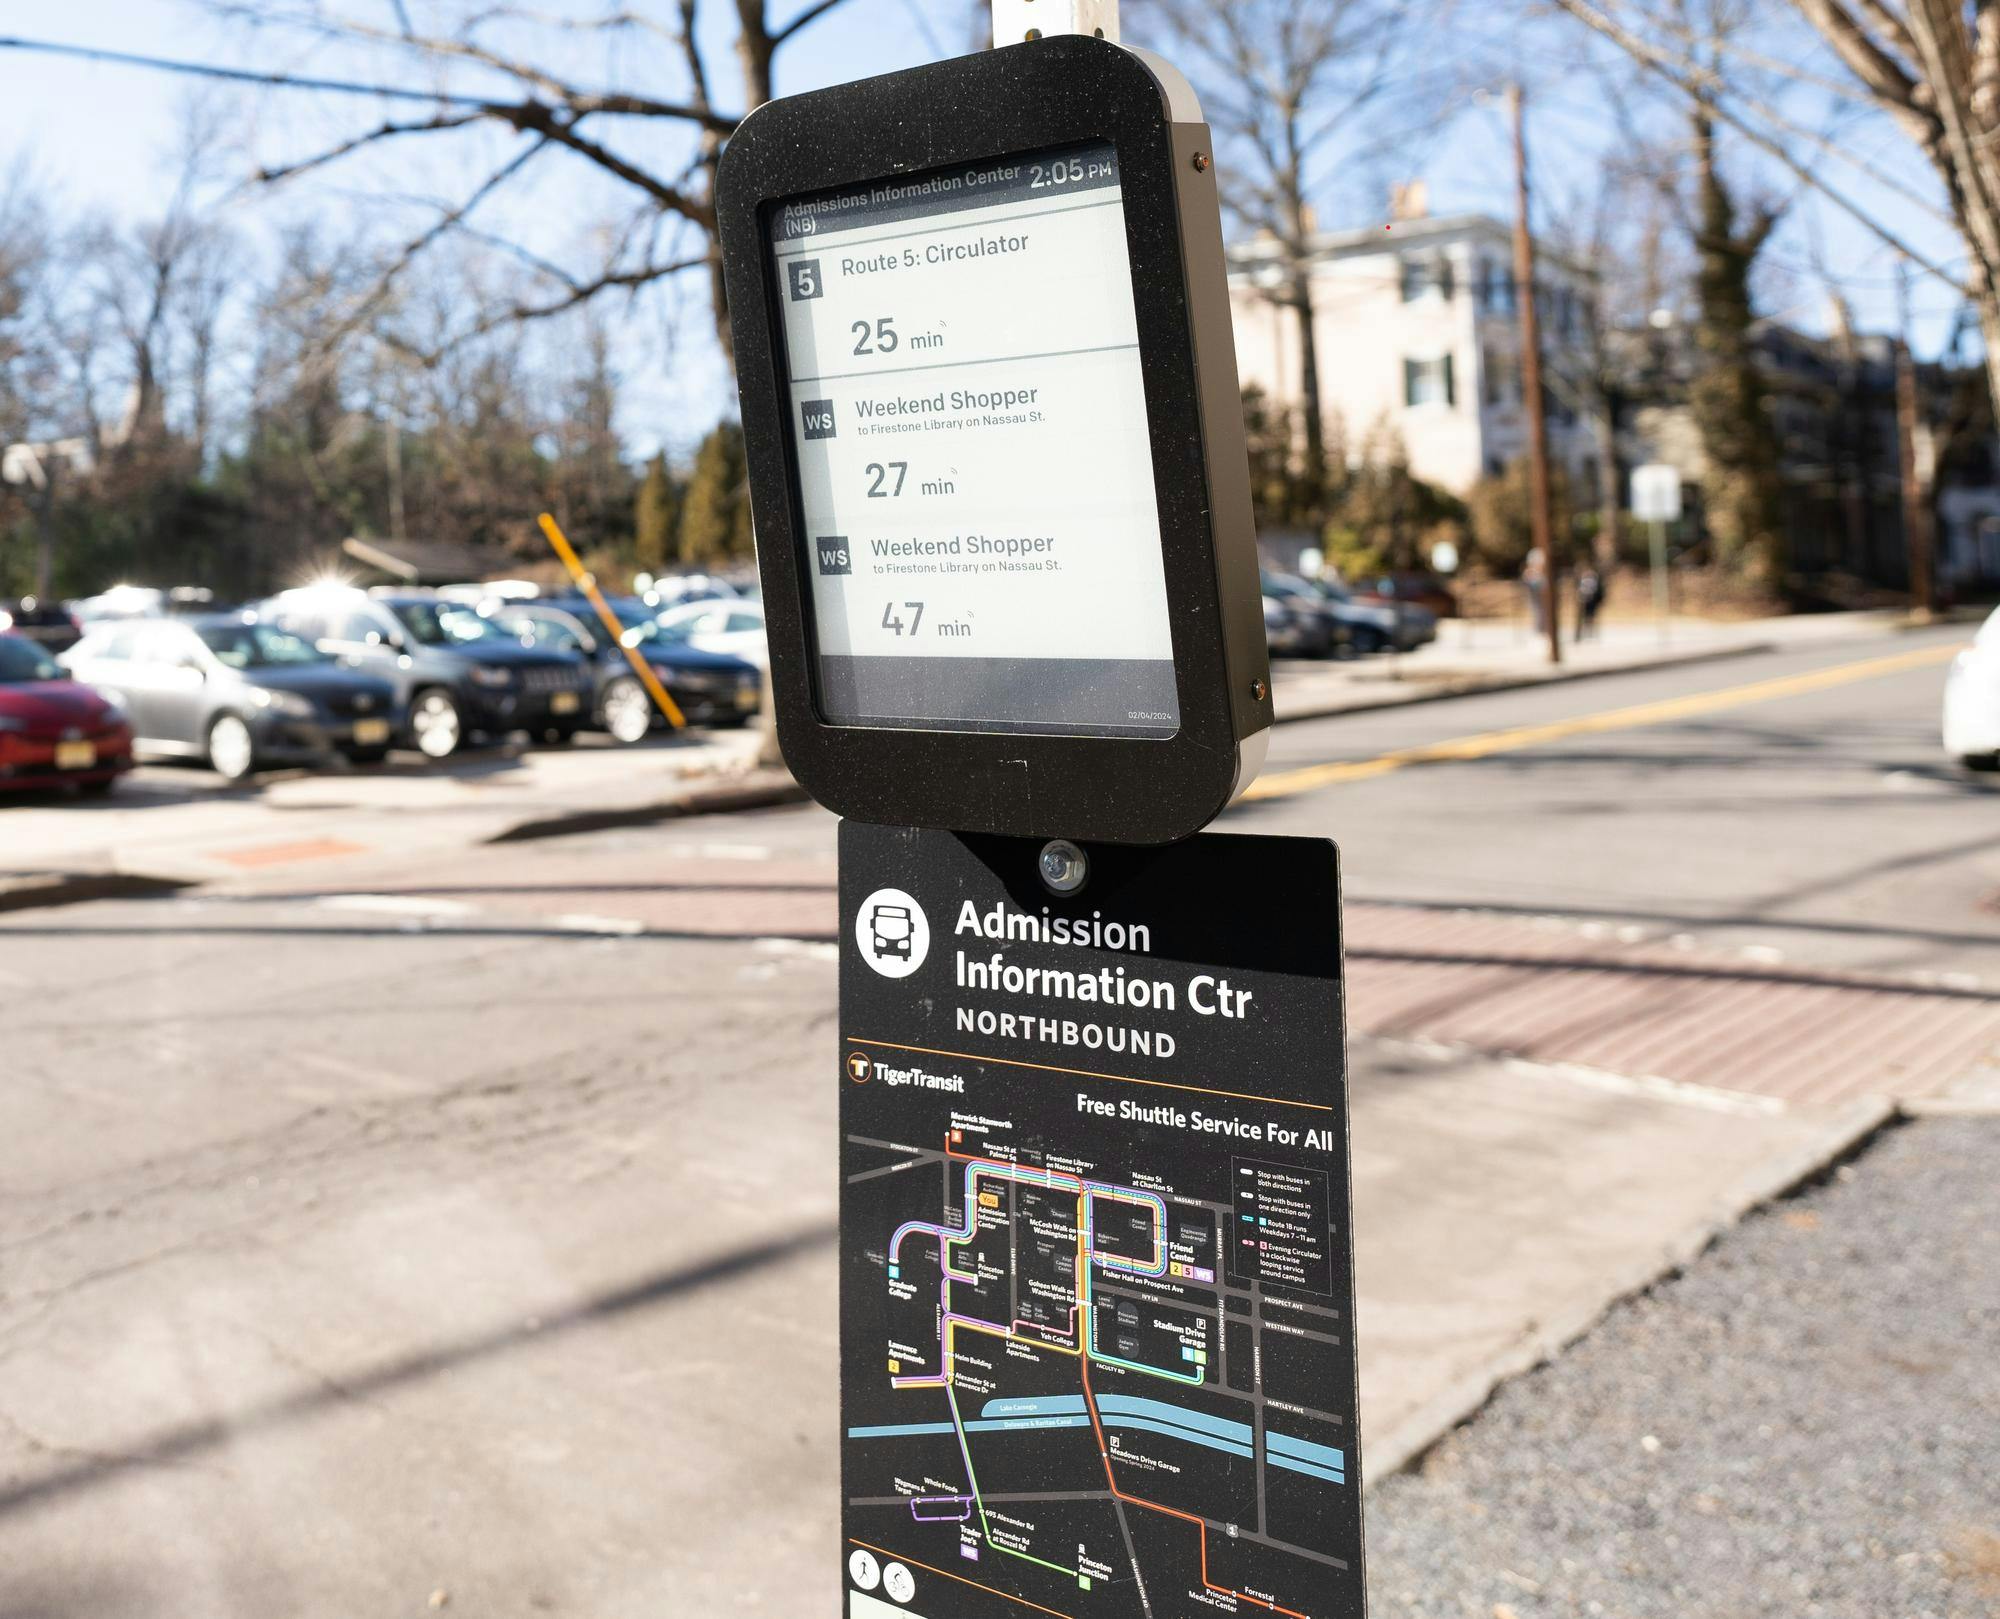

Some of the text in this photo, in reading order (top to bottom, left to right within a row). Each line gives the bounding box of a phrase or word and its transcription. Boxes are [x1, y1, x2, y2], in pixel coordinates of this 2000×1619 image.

[1029, 158, 1112, 189] 2:05 PM
[784, 165, 1021, 219] Admissions Information Center
[785, 218, 816, 236] (NB)
[842, 234, 1029, 276] Route 5: Circulator
[798, 269, 814, 296] 5
[852, 318, 944, 356] 25 min
[856, 388, 1038, 418] Weekend Shopper
[806, 413, 832, 431] WS
[858, 411, 1045, 436] to Firestone Library on Nassau St.
[865, 463, 955, 498] 27 min
[871, 536, 1054, 558] Weekend Shopper
[821, 550, 847, 566] WS
[874, 559, 1062, 574] to Firestone Library on Nassau St.
[881, 602, 971, 637] 47 min
[1128, 711, 1172, 720] 02/04/2024
[955, 900, 1150, 952] Admission
[956, 950, 1252, 1020] Information Ctr
[956, 1008, 1176, 1059] NORTHBOUND
[874, 1063, 964, 1093] TigerTransit
[951, 1112, 1012, 1129] Merwick Stanworth
[951, 1121, 989, 1133] Apartments
[1077, 1094, 1333, 1150] Free Shuttle Service For All
[983, 1142, 1002, 1151] Nassau
[989, 1150, 1008, 1159] Palmer
[1009, 1154, 1016, 1162] Sq
[1046, 1154, 1072, 1165] Firestone
[1074, 1158, 1094, 1169] Library
[1055, 1163, 1074, 1172] Nassau
[1132, 1172, 1154, 1181] Nassau
[1258, 1171, 1271, 1179] Stop
[1286, 1176, 1303, 1184] buses
[1140, 1182, 1166, 1191] Charlton
[1258, 1179, 1301, 1192] both directions
[983, 1196, 996, 1204] You
[1258, 1194, 1272, 1203] Stop
[1286, 1200, 1304, 1209] buses
[978, 1207, 1006, 1217] Admission
[978, 1213, 1009, 1225] Information
[1270, 1205, 1296, 1216] direction
[1298, 1211, 1311, 1219] only
[978, 1221, 996, 1230] Center
[1030, 1219, 1052, 1230] McCosh
[1053, 1224, 1068, 1232] Walk
[1268, 1220, 1285, 1228] Route
[1034, 1227, 1067, 1240] Washington
[1259, 1227, 1289, 1238] Weekdays
[1170, 1242, 1193, 1253] Friend
[1269, 1244, 1291, 1254] Evening
[1292, 1248, 1321, 1259] Circulator
[1170, 1252, 1195, 1263] Center
[1271, 1253, 1300, 1264] clockwise
[978, 1264, 1004, 1275] Princeton
[1260, 1259, 1304, 1274] looping service
[978, 1271, 998, 1281] Station
[1103, 1270, 1120, 1280] Fisher
[1122, 1275, 1134, 1283] Hall
[1144, 1279, 1170, 1291] Prospect
[1171, 1285, 1184, 1293] Ave
[1260, 1269, 1305, 1283] around campus
[889, 1279, 917, 1293] Graduate
[1029, 1280, 1050, 1290] Goheen
[1051, 1284, 1066, 1292] Walk
[889, 1287, 912, 1300] College
[1032, 1287, 1066, 1300] Washington
[1264, 1297, 1303, 1310] PROSPECT AVE
[1154, 1320, 1205, 1338] Stadium Drive
[1265, 1322, 1291, 1332] WESTERN
[1041, 1332, 1074, 1346] Yeh College
[1179, 1335, 1206, 1349] Garage
[888, 1340, 917, 1354] Lawrence
[1006, 1341, 1030, 1352] Lakeside
[888, 1349, 926, 1365] Apartments
[1006, 1349, 1039, 1361] Apartments
[1096, 1363, 1118, 1373] FACULTY
[955, 1380, 980, 1392] Lawrence
[956, 1373, 982, 1385] Alexander
[983, 1379, 989, 1387] St
[1268, 1400, 1292, 1410] HARTLEY
[1110, 1447, 1180, 1473] Meadows Drive Garage
[924, 1476, 958, 1493] Whole Foods
[960, 1525, 982, 1538] Trader
[993, 1528, 1030, 1545] Alexander Rd
[960, 1533, 977, 1545] Joe's
[1078, 1555, 1112, 1573] Princeton
[1079, 1565, 1109, 1581] Junction
[1206, 1588, 1237, 1605] Princeton
[1245, 1586, 1274, 1602] Forrestal
[1188, 1590, 1237, 1613] Medical Center
